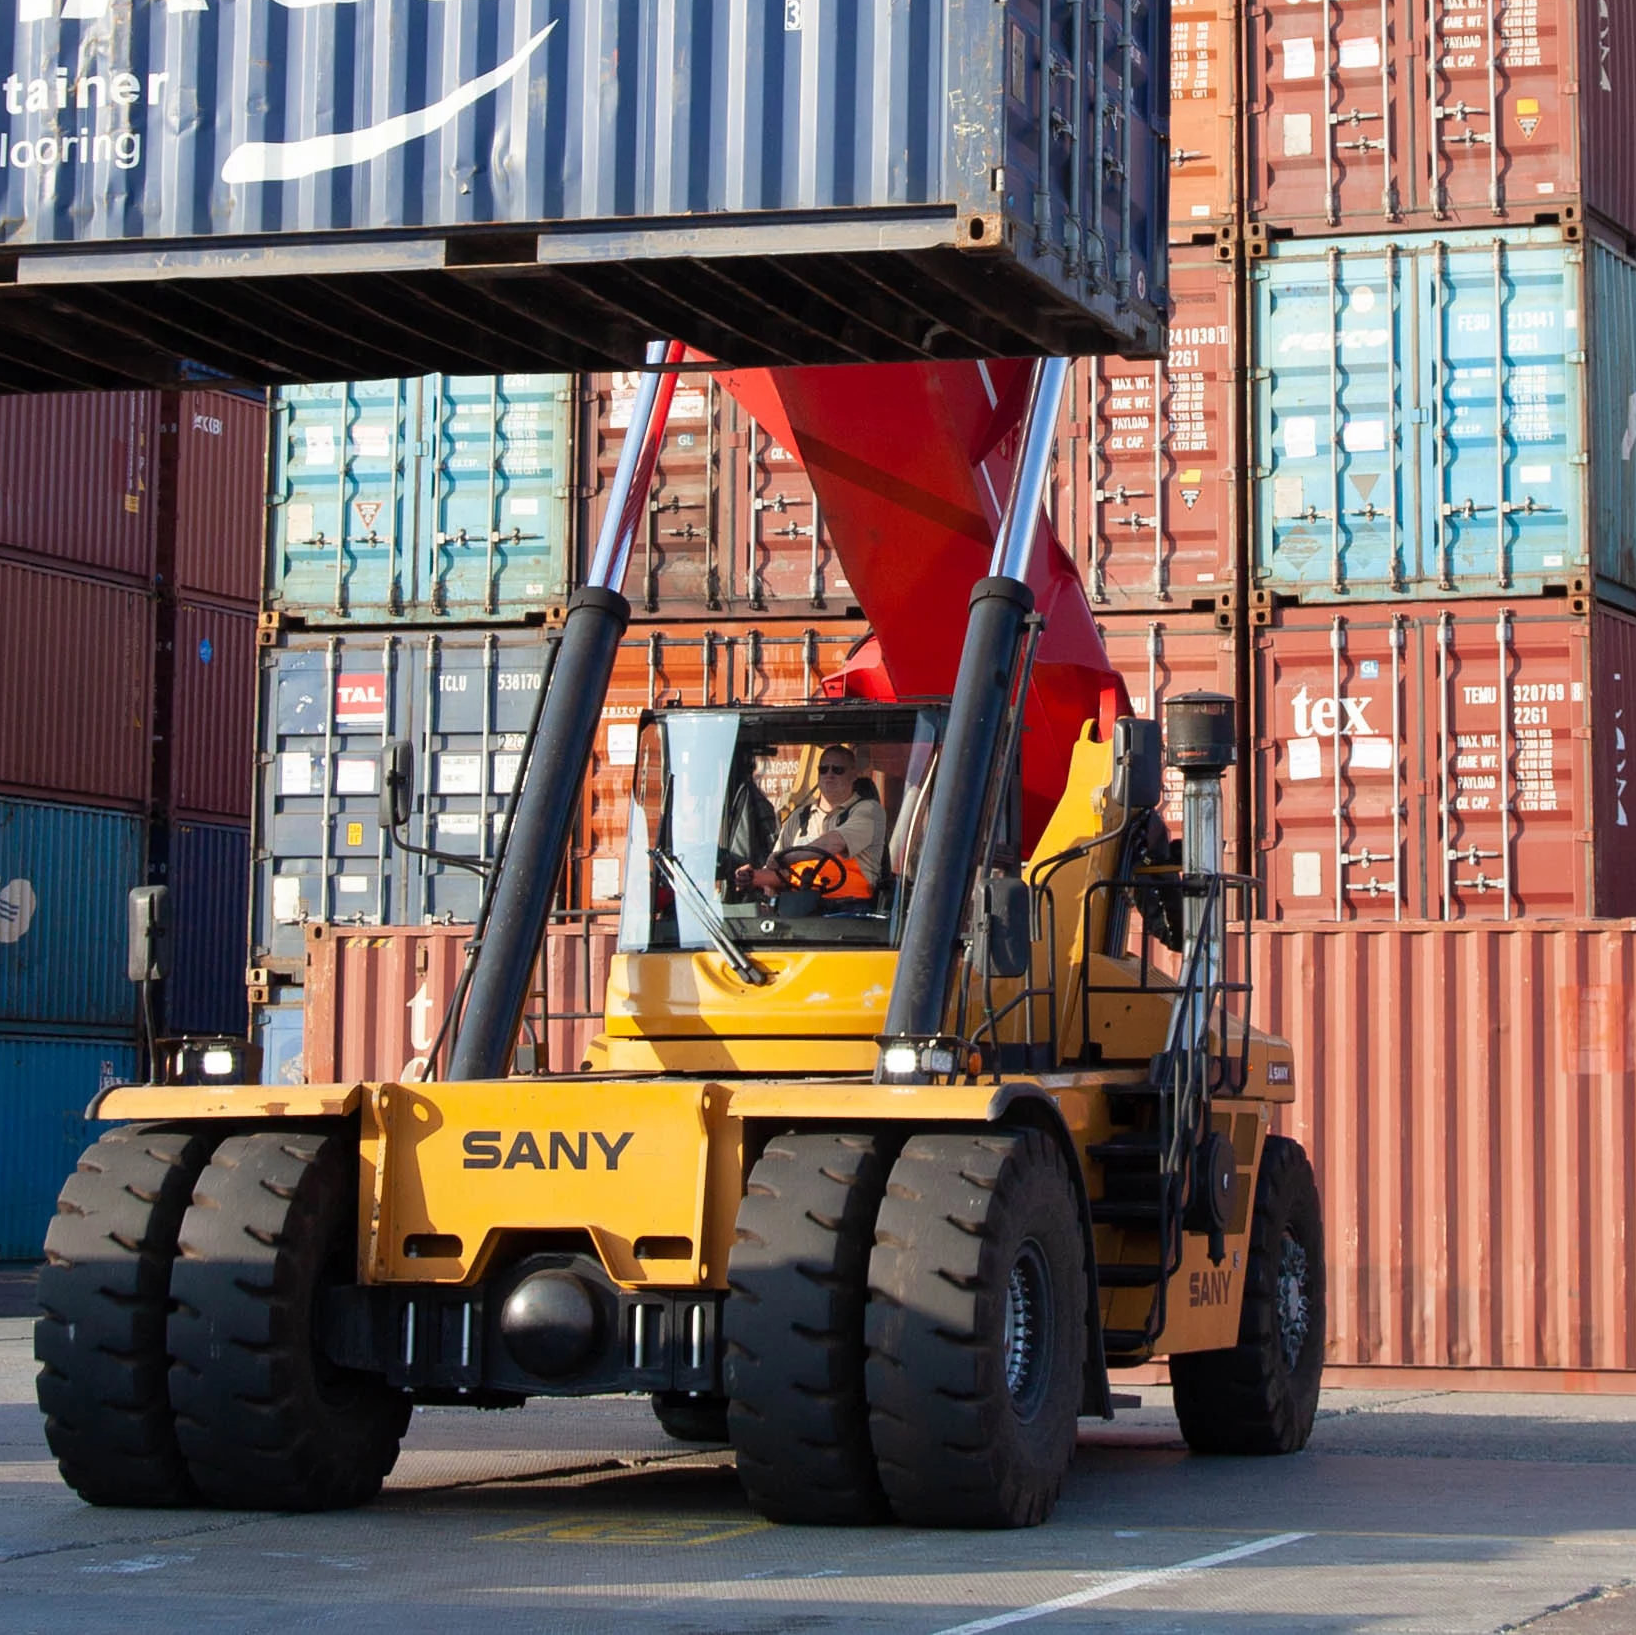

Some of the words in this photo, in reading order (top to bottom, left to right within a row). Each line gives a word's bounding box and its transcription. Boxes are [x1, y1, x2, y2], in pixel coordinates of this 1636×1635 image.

[785, 0, 802, 31] 3
[1444, 35, 1481, 48] PAYLOAD
[1458, 315, 1490, 331] FESU
[1168, 350, 1199, 367] 22G1
[1111, 417, 1149, 430] PAYLOAD
[677, 434, 694, 446] GL
[1361, 662, 1378, 675] GL
[337, 687, 383, 703] TAL
[439, 675, 467, 692] TCLU
[498, 673, 541, 690] 538170
[1463, 687, 1496, 704] TEMU
[1513, 684, 1565, 702] 320769
[1513, 706, 1548, 725] 22G1
[1457, 776, 1496, 789] PAYLOAD
[1272, 1066, 1289, 1081] SANY
[463, 1130, 634, 1171] SANY
[1189, 1269, 1232, 1308] SANY
